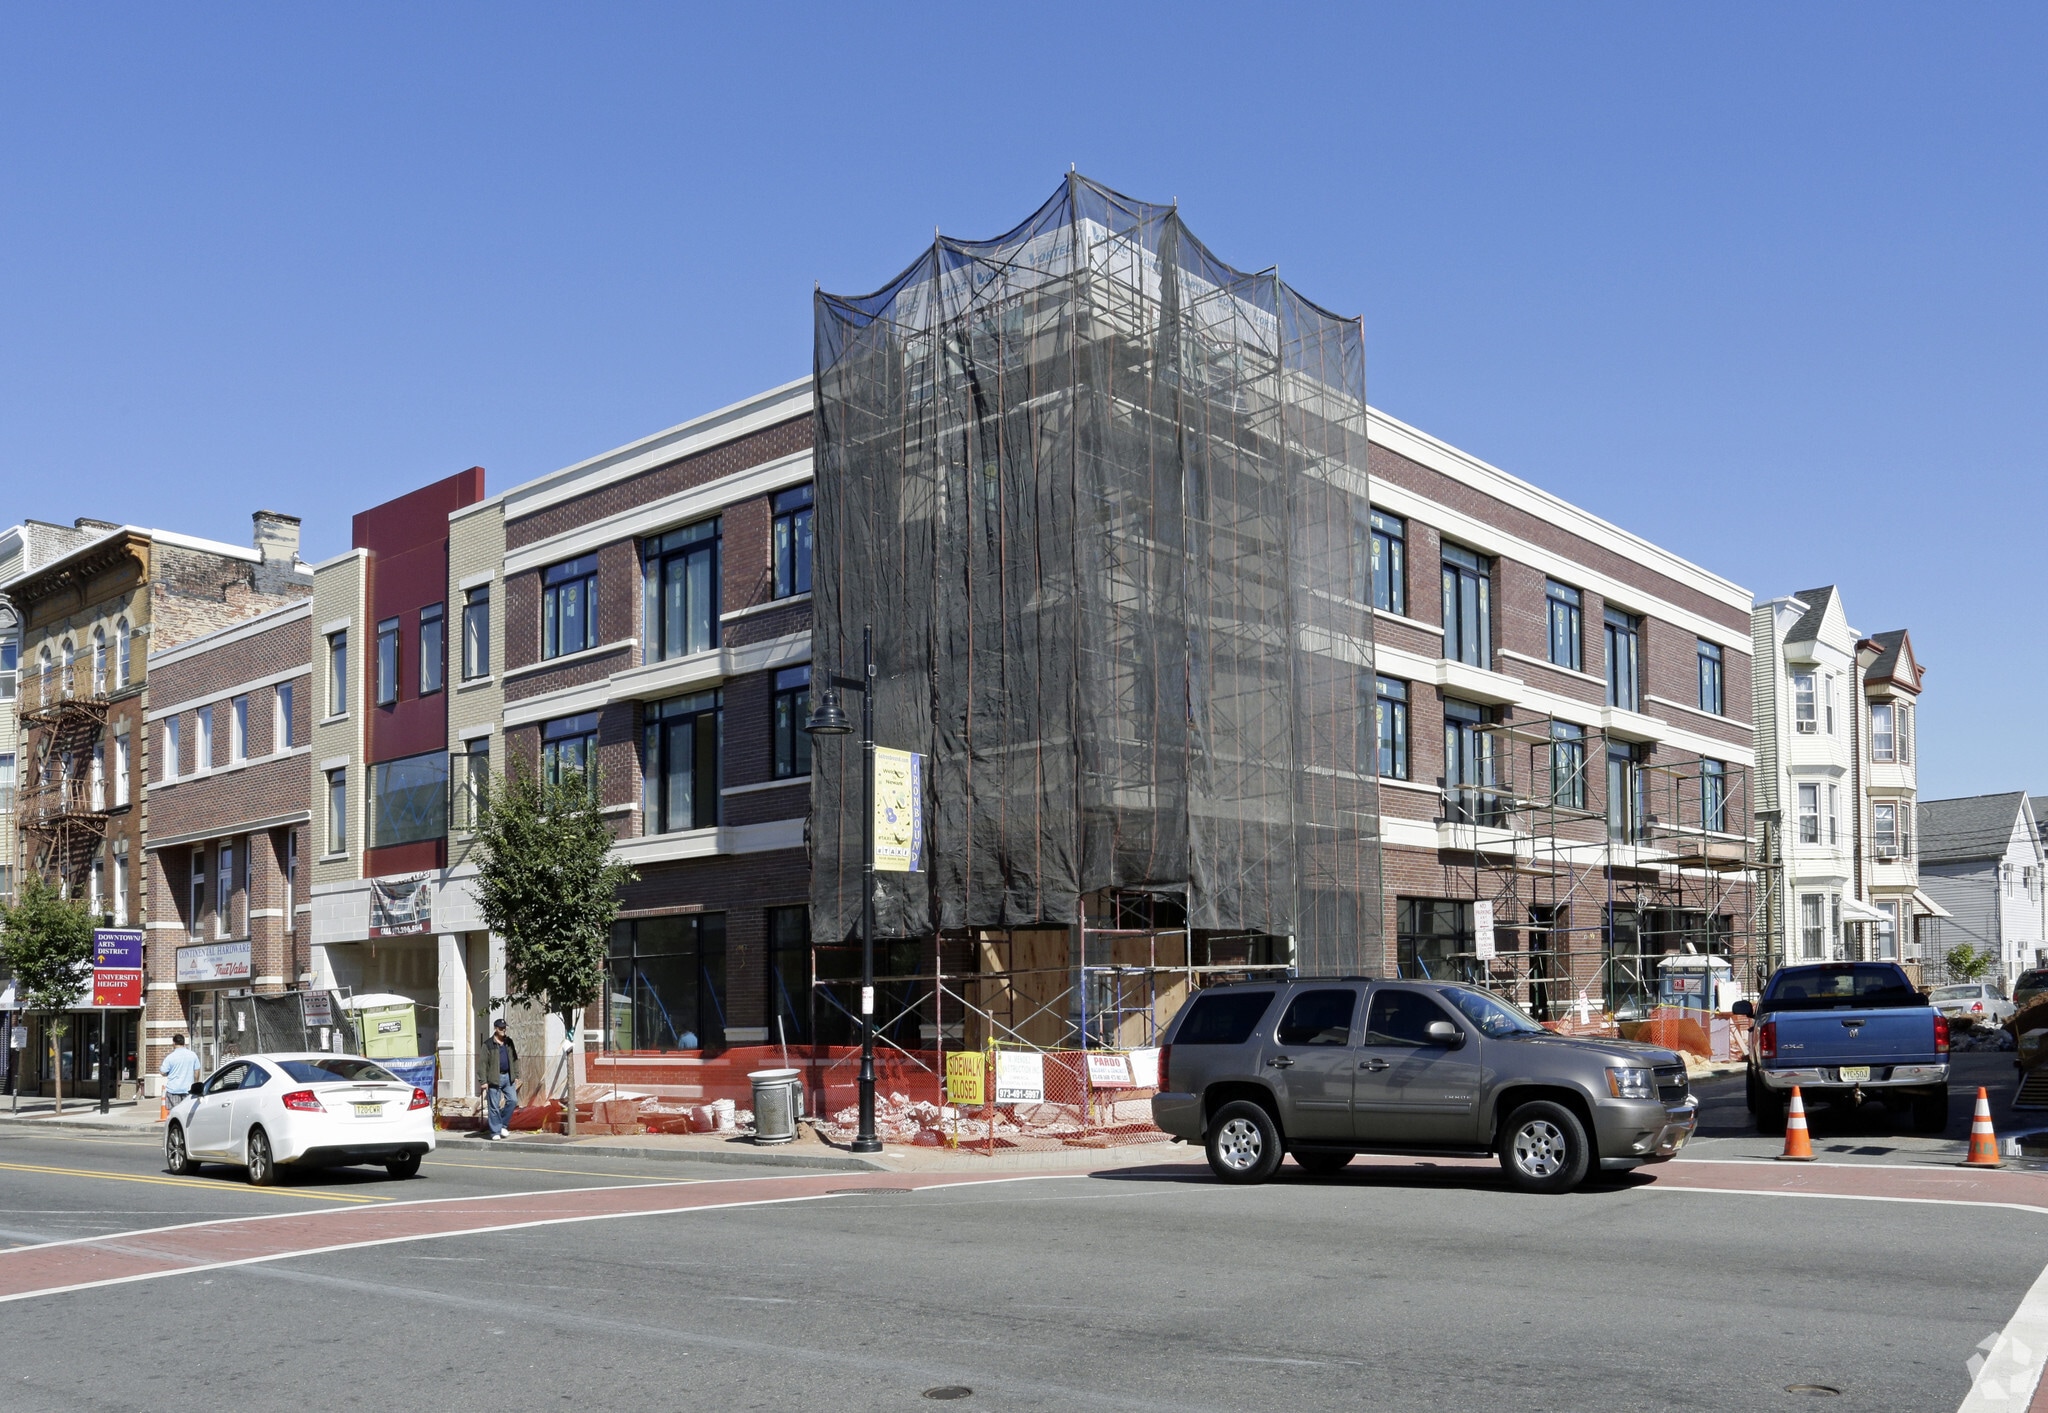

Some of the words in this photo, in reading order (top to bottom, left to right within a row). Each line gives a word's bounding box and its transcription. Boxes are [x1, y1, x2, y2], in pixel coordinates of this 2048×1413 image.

[911, 764, 920, 862] IRONBOUND
[98, 934, 141, 942] DOWNTOWN
[178, 946, 215, 959] CONTINENTAL
[217, 943, 250, 956] HARDWARE
[97, 973, 139, 981] UNIVERSITY
[949, 1056, 982, 1077] SIDEWALK
[1093, 1056, 1121, 1067] PARDO
[952, 1079, 977, 1100] CLOSED
